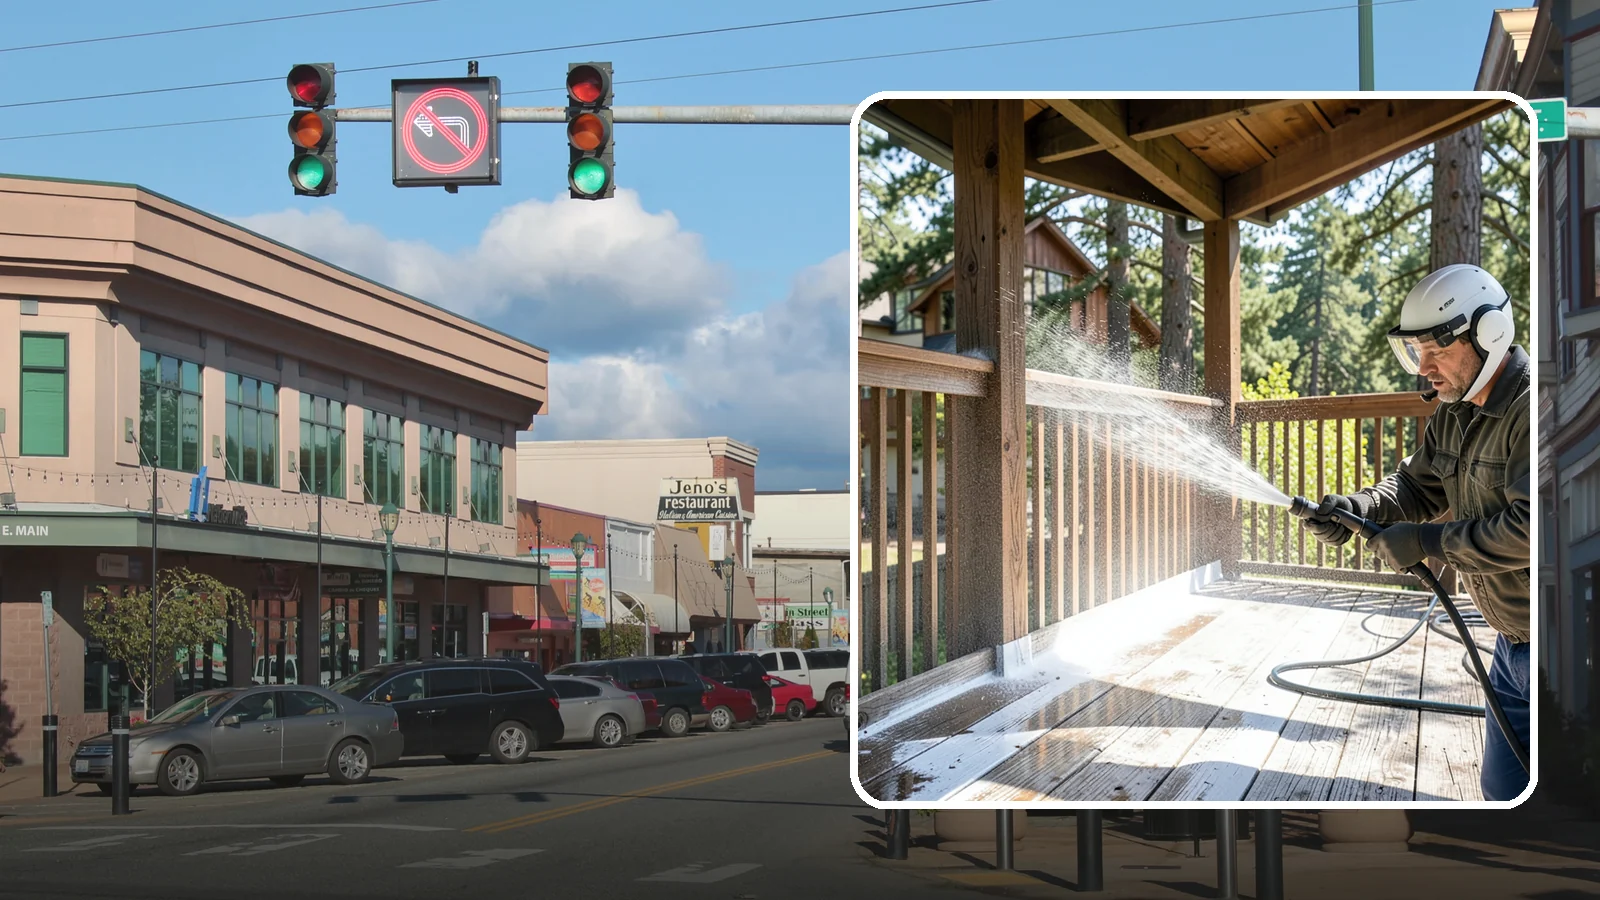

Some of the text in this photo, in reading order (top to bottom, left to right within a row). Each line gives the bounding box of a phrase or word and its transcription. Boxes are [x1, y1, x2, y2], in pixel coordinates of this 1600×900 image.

[670, 480, 728, 494] Jeno's
[665, 496, 731, 509] restaurant
[659, 510, 682, 519] Italian
[686, 510, 714, 519] American
[715, 510, 737, 519] Cuisine
[2, 525, 49, 536] E. MAIN
[797, 608, 828, 616] Street
